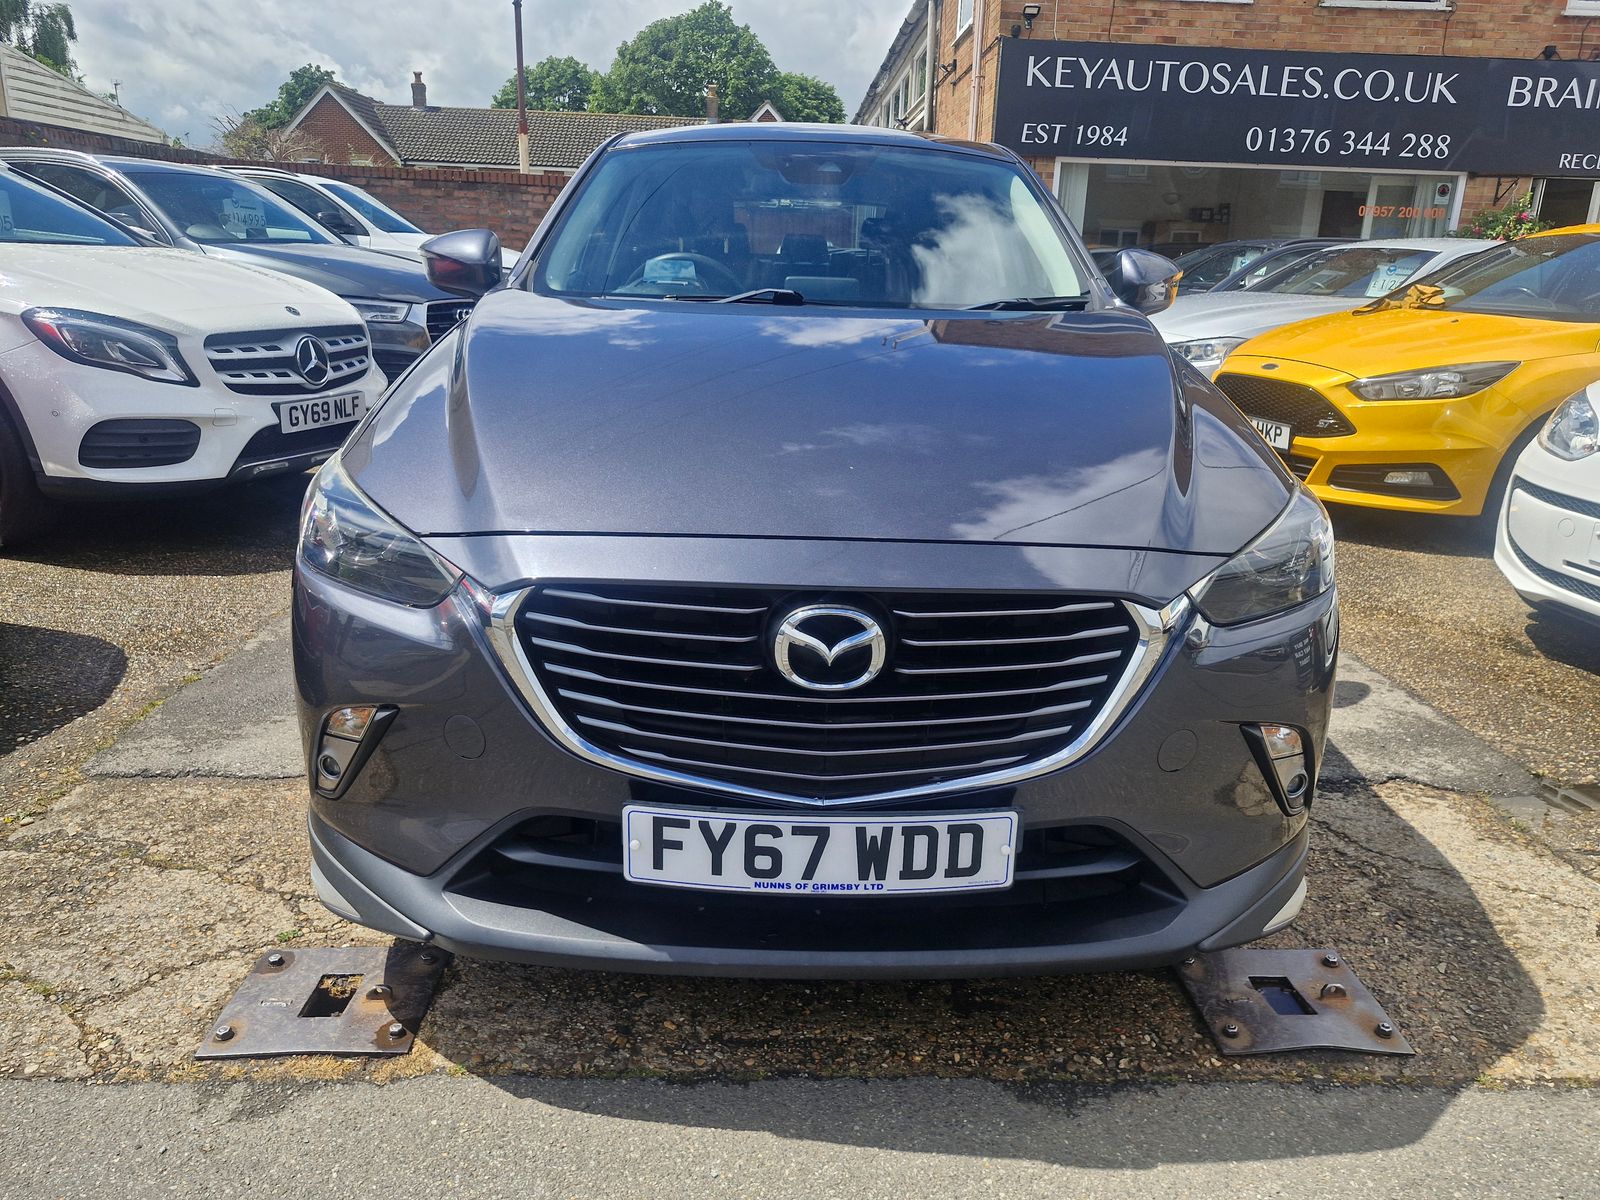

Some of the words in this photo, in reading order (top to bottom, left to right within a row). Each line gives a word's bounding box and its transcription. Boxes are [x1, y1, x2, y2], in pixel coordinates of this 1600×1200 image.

[1025, 55, 1460, 104] KEYAUTOSALES.CO.UK
[1506, 76, 1600, 109] BRAI
[1021, 122, 1067, 144] EST
[1076, 124, 1128, 146] 1984
[1246, 126, 1332, 154] 01376
[1339, 130, 1391, 156] 344
[1398, 133, 1451, 159] 288
[1559, 153, 1600, 170] REC
[289, 401, 330, 427] GY69
[334, 396, 359, 419] NLF
[653, 816, 831, 880] FY67
[855, 823, 984, 881] WDD
[754, 881, 792, 890] NUNNS
[812, 883, 860, 891] GRIMSBY
[864, 883, 884, 891] LTD
